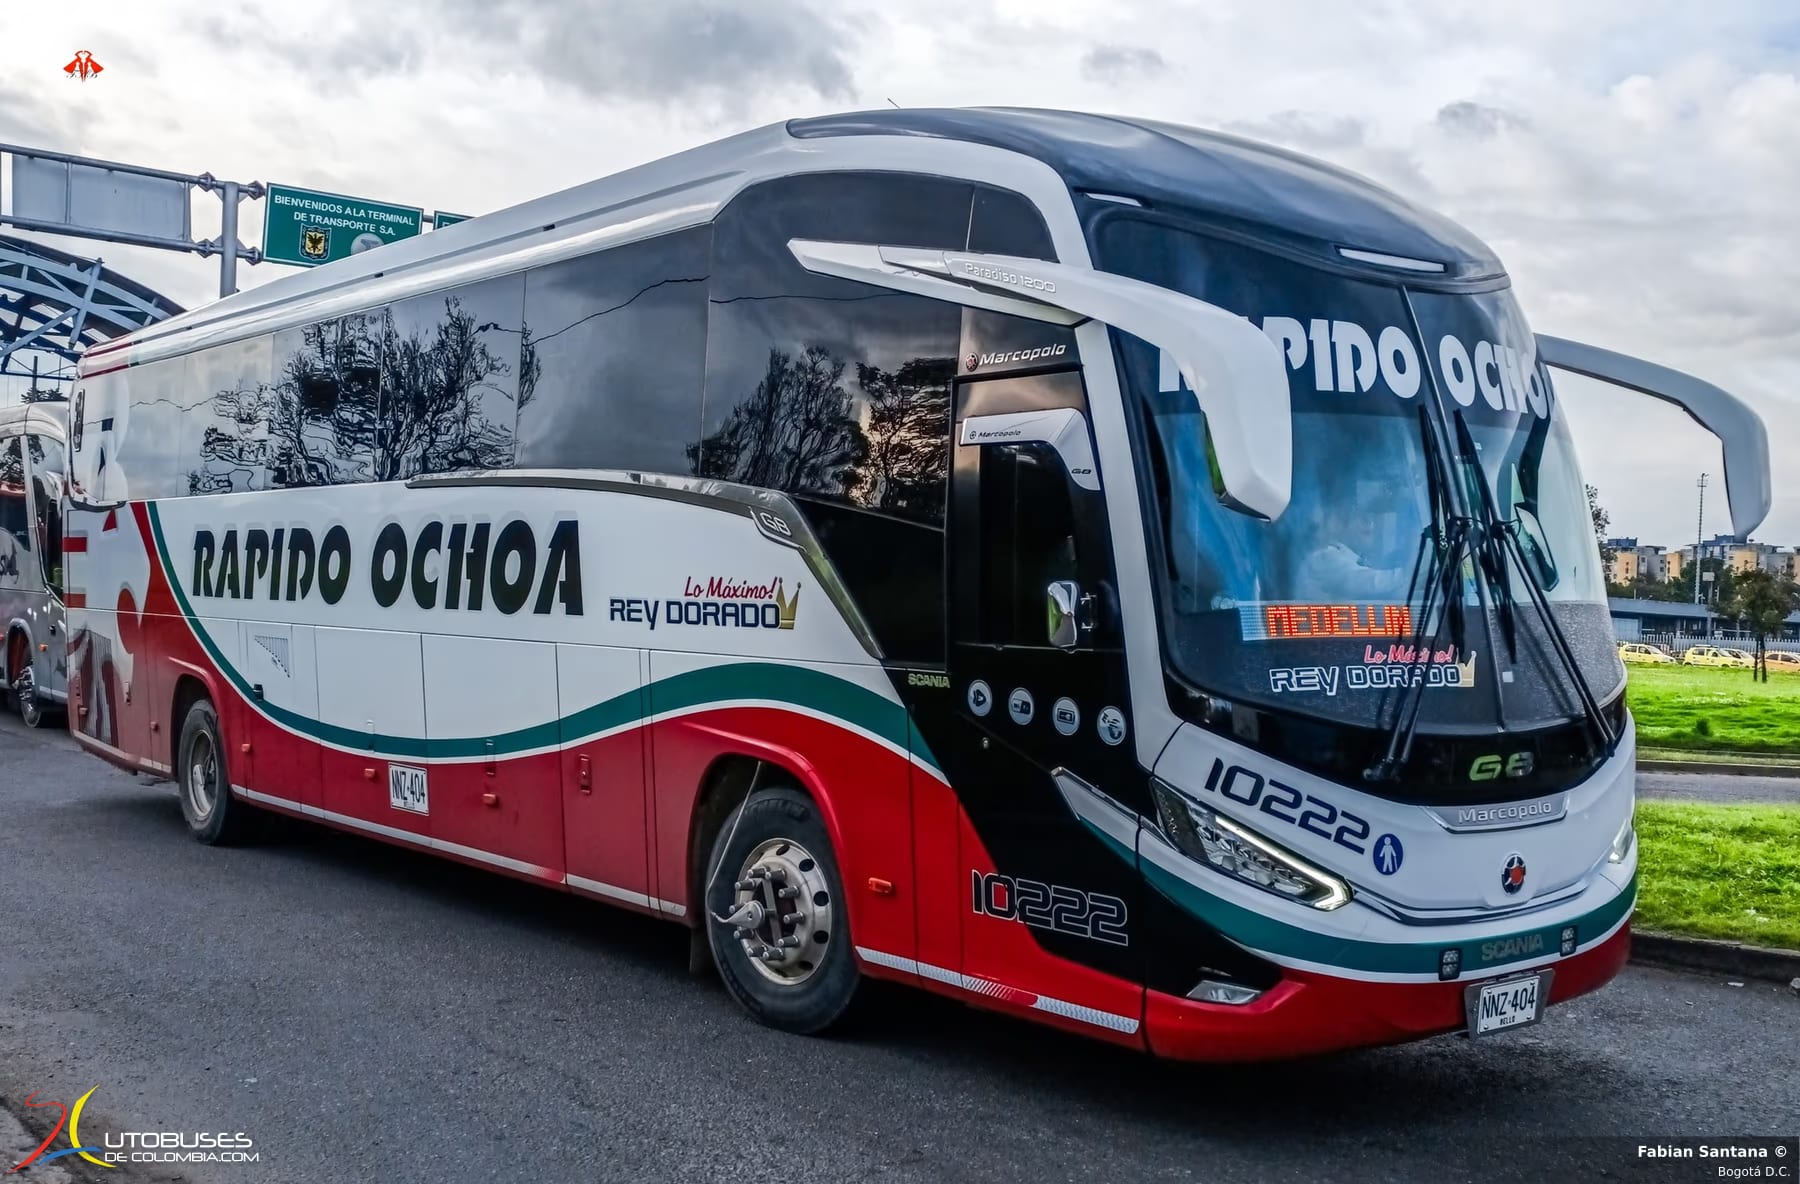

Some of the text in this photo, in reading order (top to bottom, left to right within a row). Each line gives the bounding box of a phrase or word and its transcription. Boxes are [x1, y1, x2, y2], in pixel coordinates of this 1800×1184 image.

[274, 194, 415, 226] BIENVENIDOS A LA TERMINAL
[293, 211, 307, 222] DE
[309, 213, 376, 233] TRANSPORTE
[965, 262, 1056, 293] Paradiso 1200
[979, 343, 1067, 366] Marcopolo
[1159, 316, 1421, 399] PIDO
[978, 430, 1022, 438] Marcopolo
[760, 511, 792, 537] G8
[193, 525, 352, 605] RAPIDO
[371, 519, 584, 616] OCHOA
[684, 576, 778, 600] Lo Máximo!
[610, 598, 781, 631] REY DORADO
[1266, 604, 1412, 637] MEDELLIN
[1364, 644, 1388, 664] Lo
[907, 673, 951, 689] SCANIA
[1269, 664, 1462, 696] REY DORADO
[1468, 751, 1526, 783] G8
[1204, 757, 1371, 857] 10222
[1458, 800, 1552, 824] Marcopolo
[971, 868, 1129, 947] 10222
[1481, 934, 1545, 961] SCANIA
